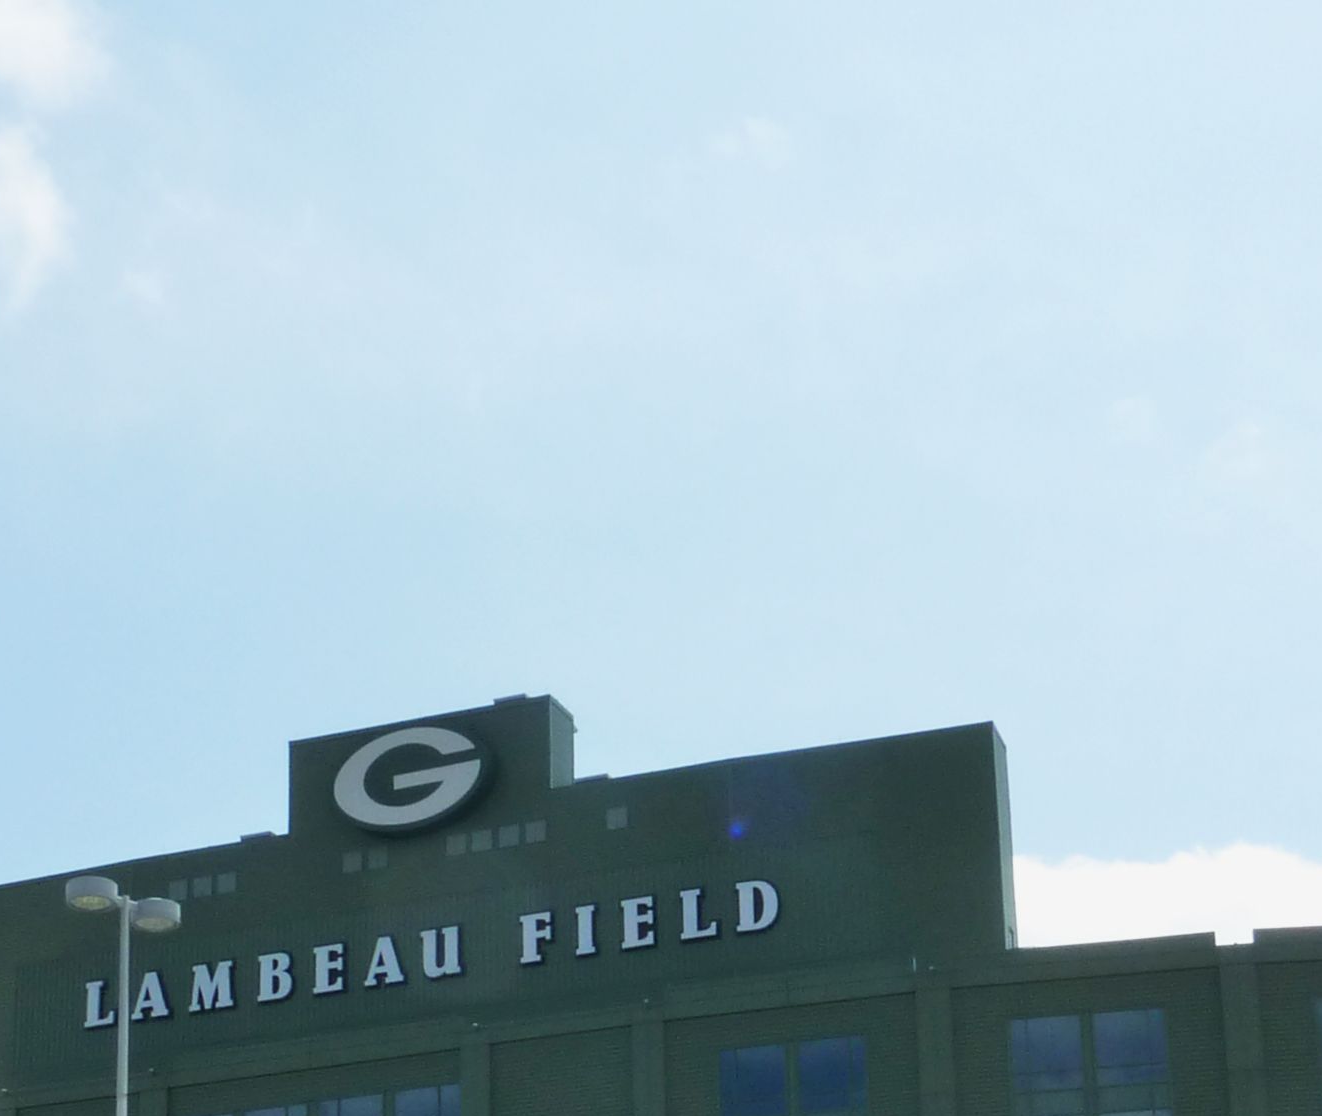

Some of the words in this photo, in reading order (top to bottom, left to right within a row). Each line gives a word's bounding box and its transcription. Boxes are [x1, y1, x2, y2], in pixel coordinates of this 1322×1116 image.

[332, 725, 482, 830] G
[83, 925, 462, 1029] LAMBEAU
[519, 879, 780, 965] FIELD
